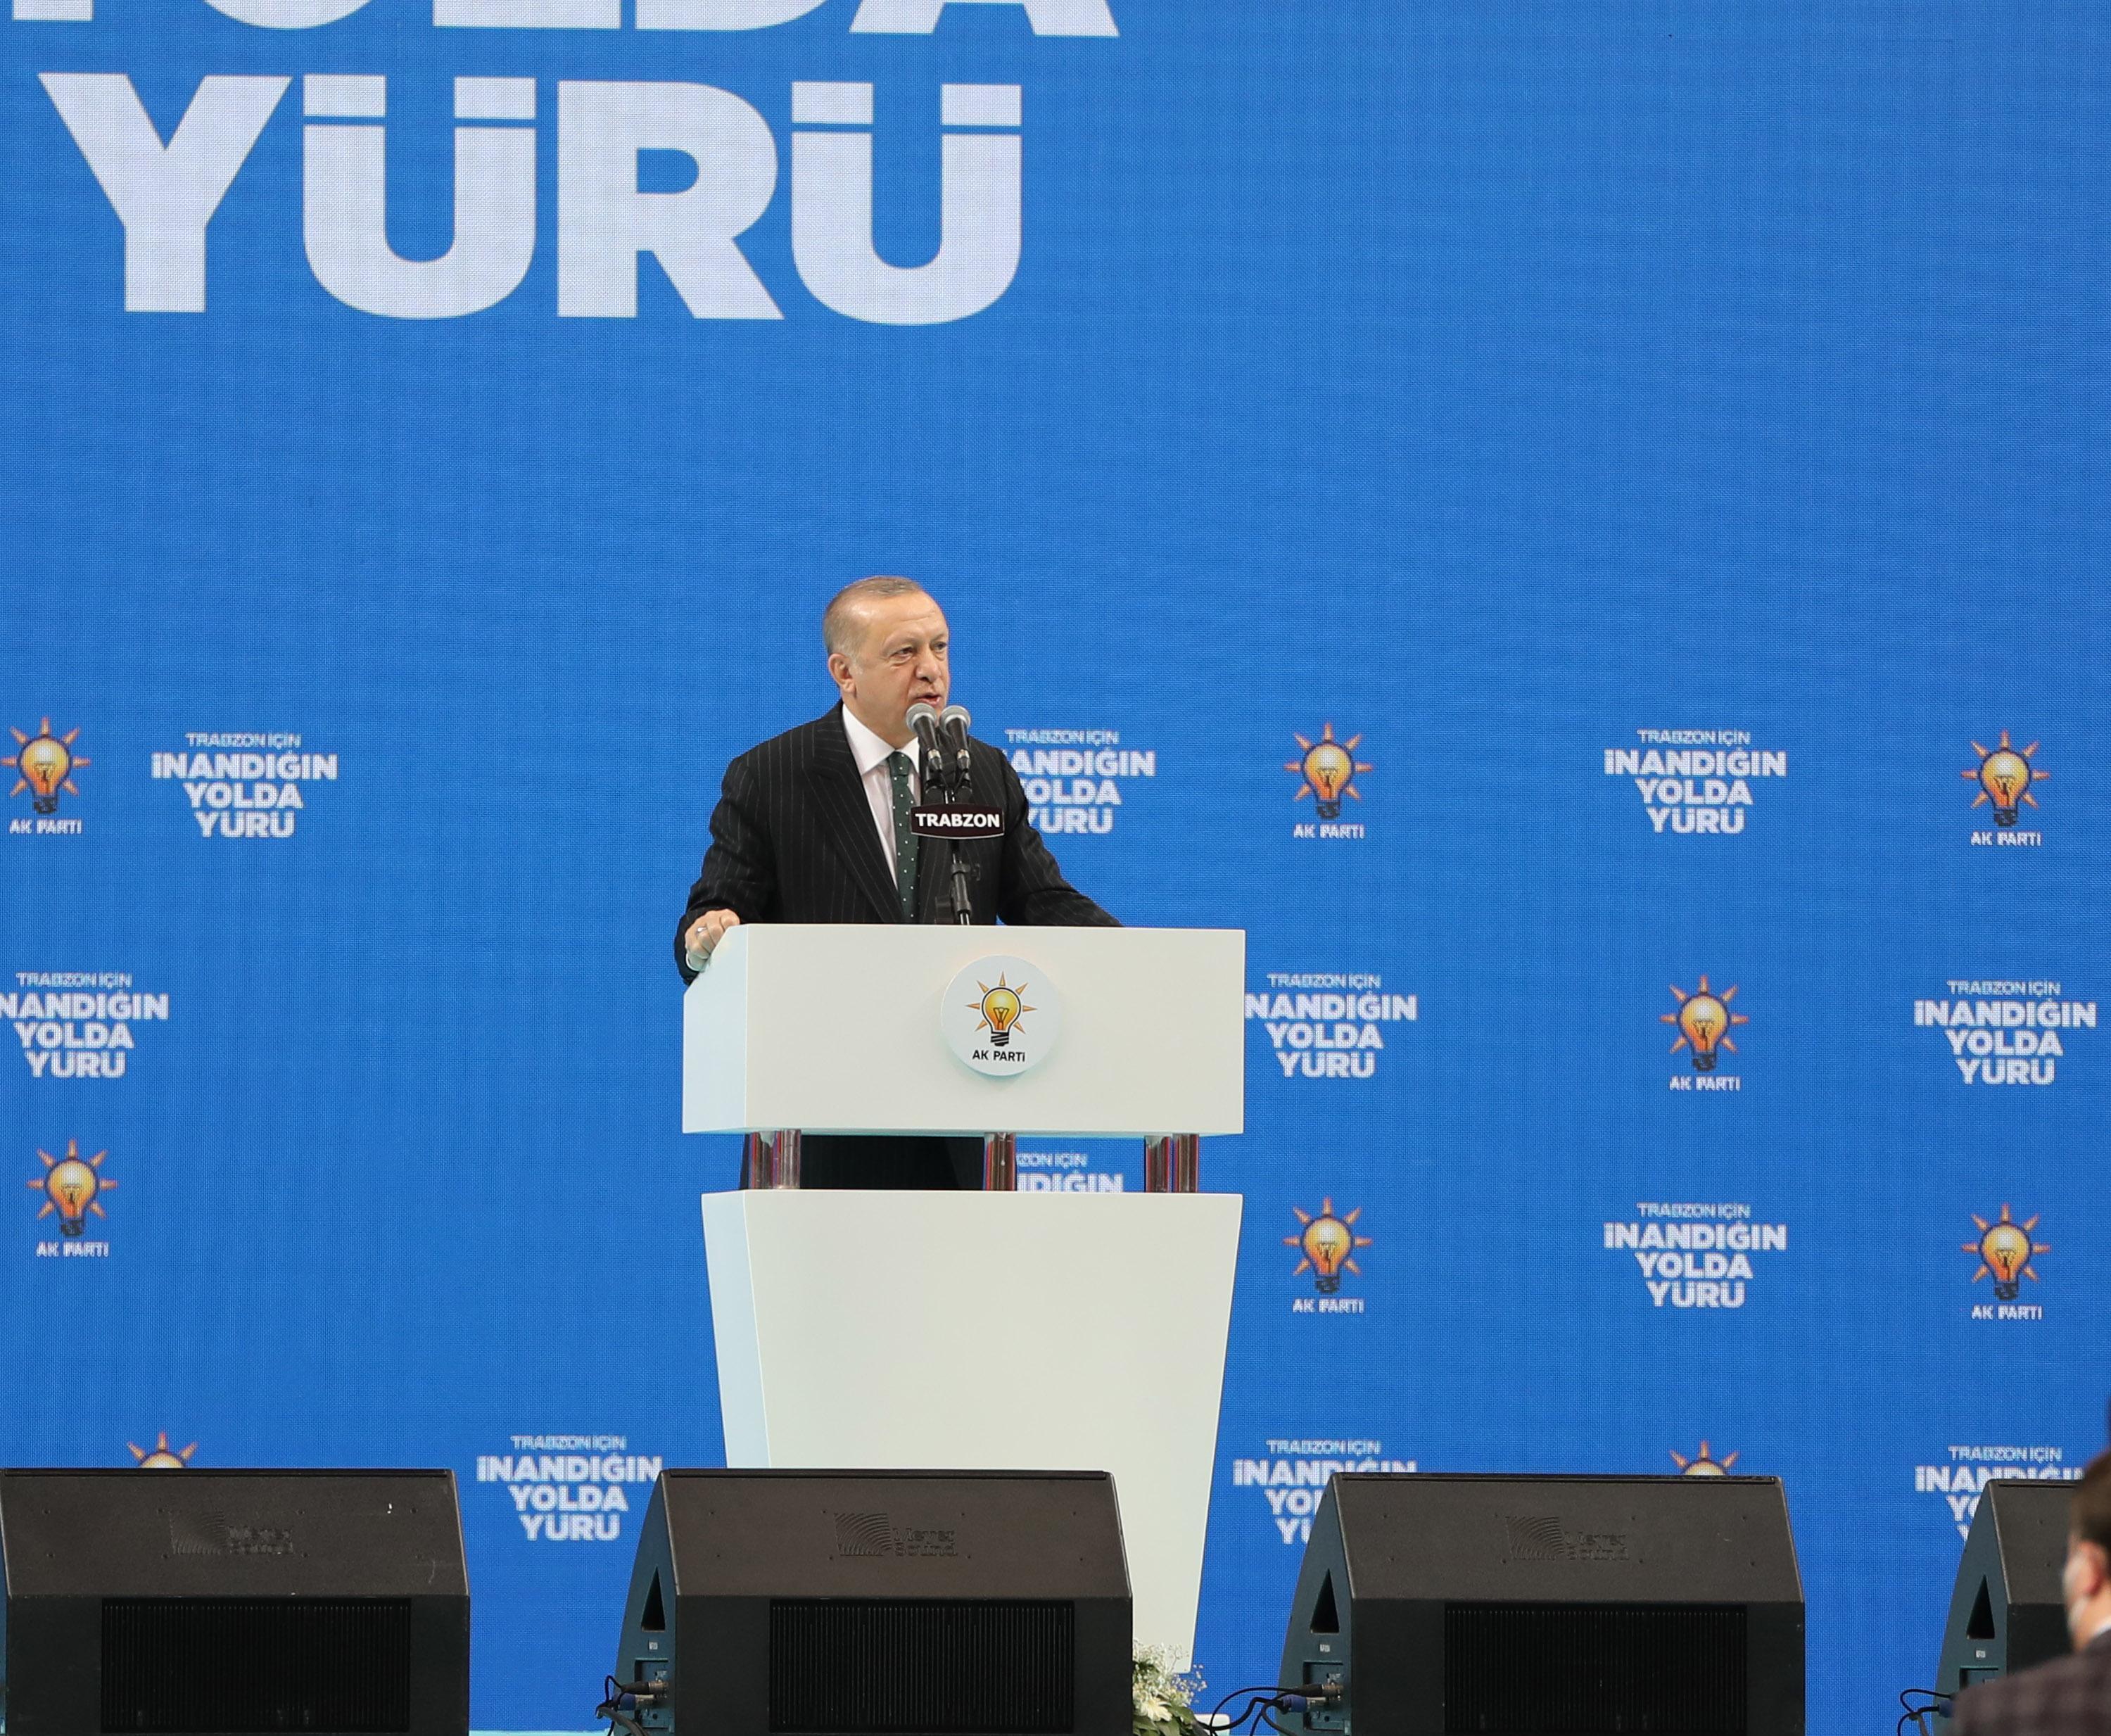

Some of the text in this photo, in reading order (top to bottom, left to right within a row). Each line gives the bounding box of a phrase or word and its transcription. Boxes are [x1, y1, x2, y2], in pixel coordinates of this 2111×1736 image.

[39, 72, 1022, 325] YÜRÜ
[184, 782, 303, 808] YOLDA
[1020, 778, 1121, 804] OLDA
[1635, 778, 1753, 804] YOLDA
[9, 820, 32, 834] AK
[915, 813, 1000, 828] TRABZON
[1293, 824, 1316, 839] AK
[1970, 831, 1993, 846] AK
[14, 1022, 134, 1048] YOLDA
[1265, 1022, 1383, 1048] YOLDA
[1946, 1029, 2063, 1056] YOLDA
[972, 1050, 989, 1060] AK
[1669, 1076, 1692, 1091] AK
[36, 1241, 59, 1257] AK
[1635, 1252, 1753, 1279] YOLDA
[1293, 1298, 1315, 1313] AK
[1971, 1305, 1993, 1319] AK
[509, 1485, 628, 1511] YOLDA
